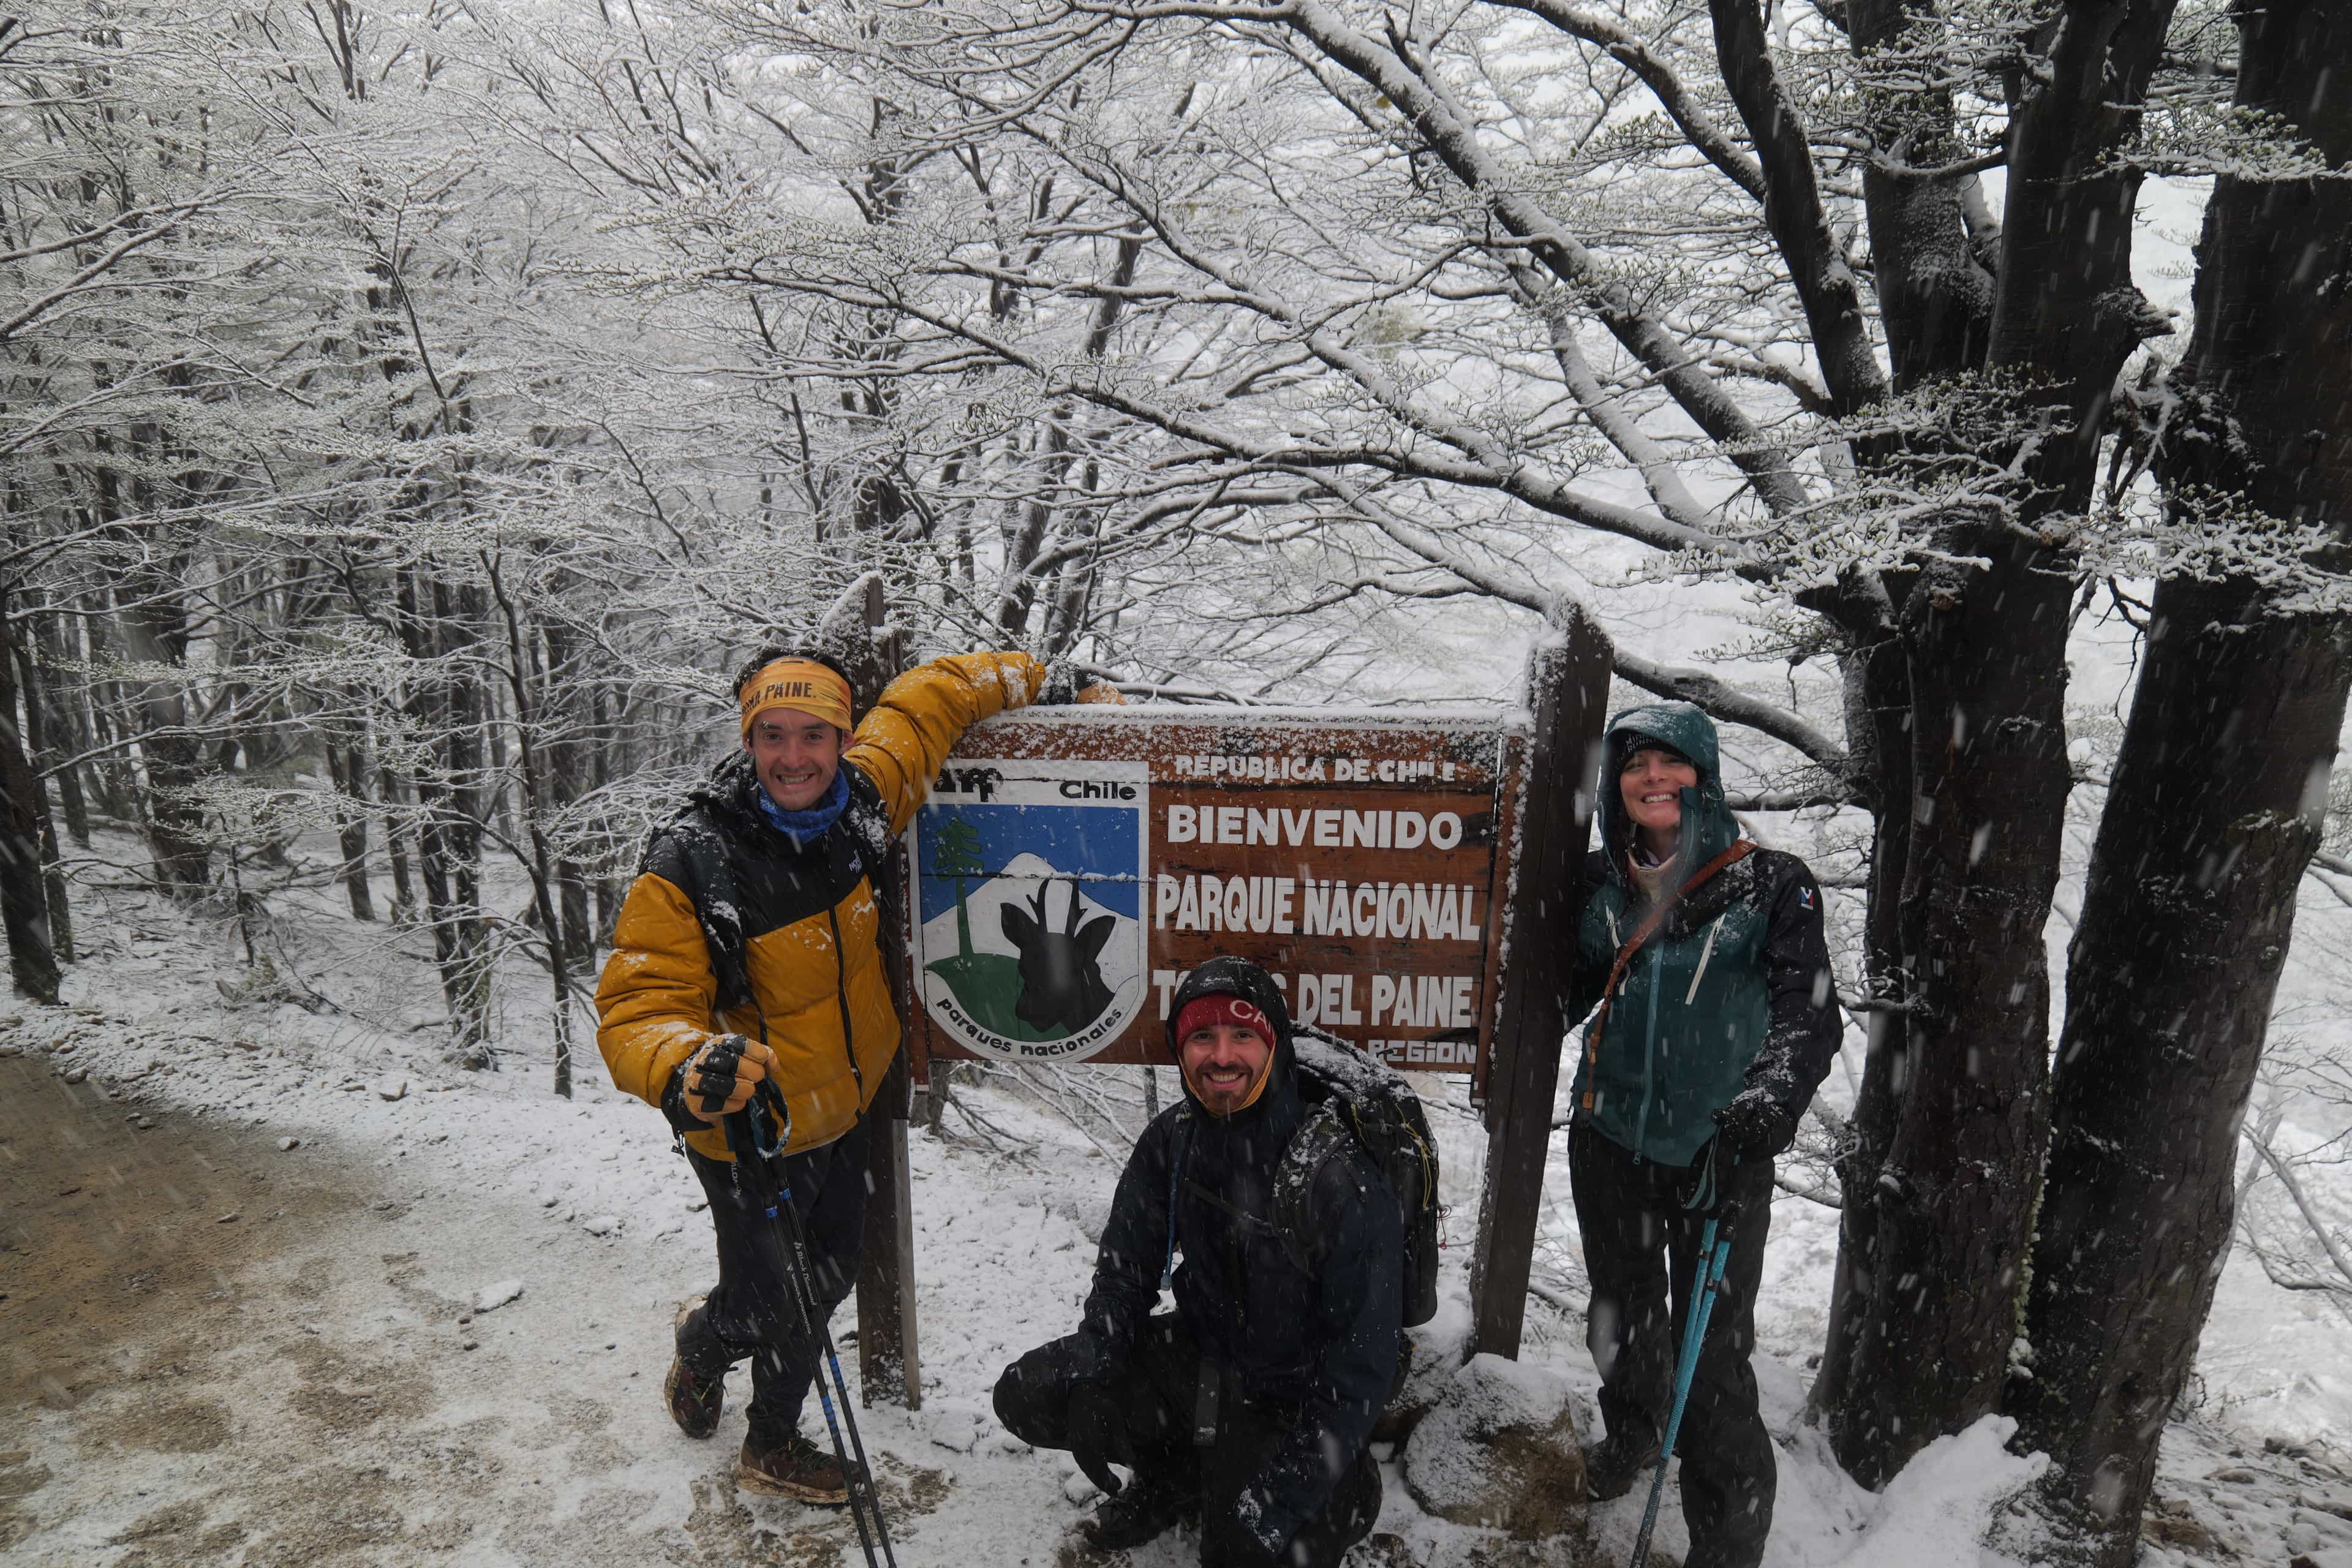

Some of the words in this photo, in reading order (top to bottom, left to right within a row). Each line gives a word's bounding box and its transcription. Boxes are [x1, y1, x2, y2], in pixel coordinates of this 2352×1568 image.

[1059, 780, 1137, 801] Chile
[1335, 758, 1371, 782] DE
[1167, 804, 1463, 850] BIENVENIDO
[1156, 873, 1295, 935] PARQUE
[1303, 879, 1480, 941] NACIONAL
[1297, 973, 1362, 1026] DEL
[1371, 974, 1473, 1028] PAINE
[937, 998, 1012, 1052] parques
[1020, 1008, 1121, 1057] nacionales
